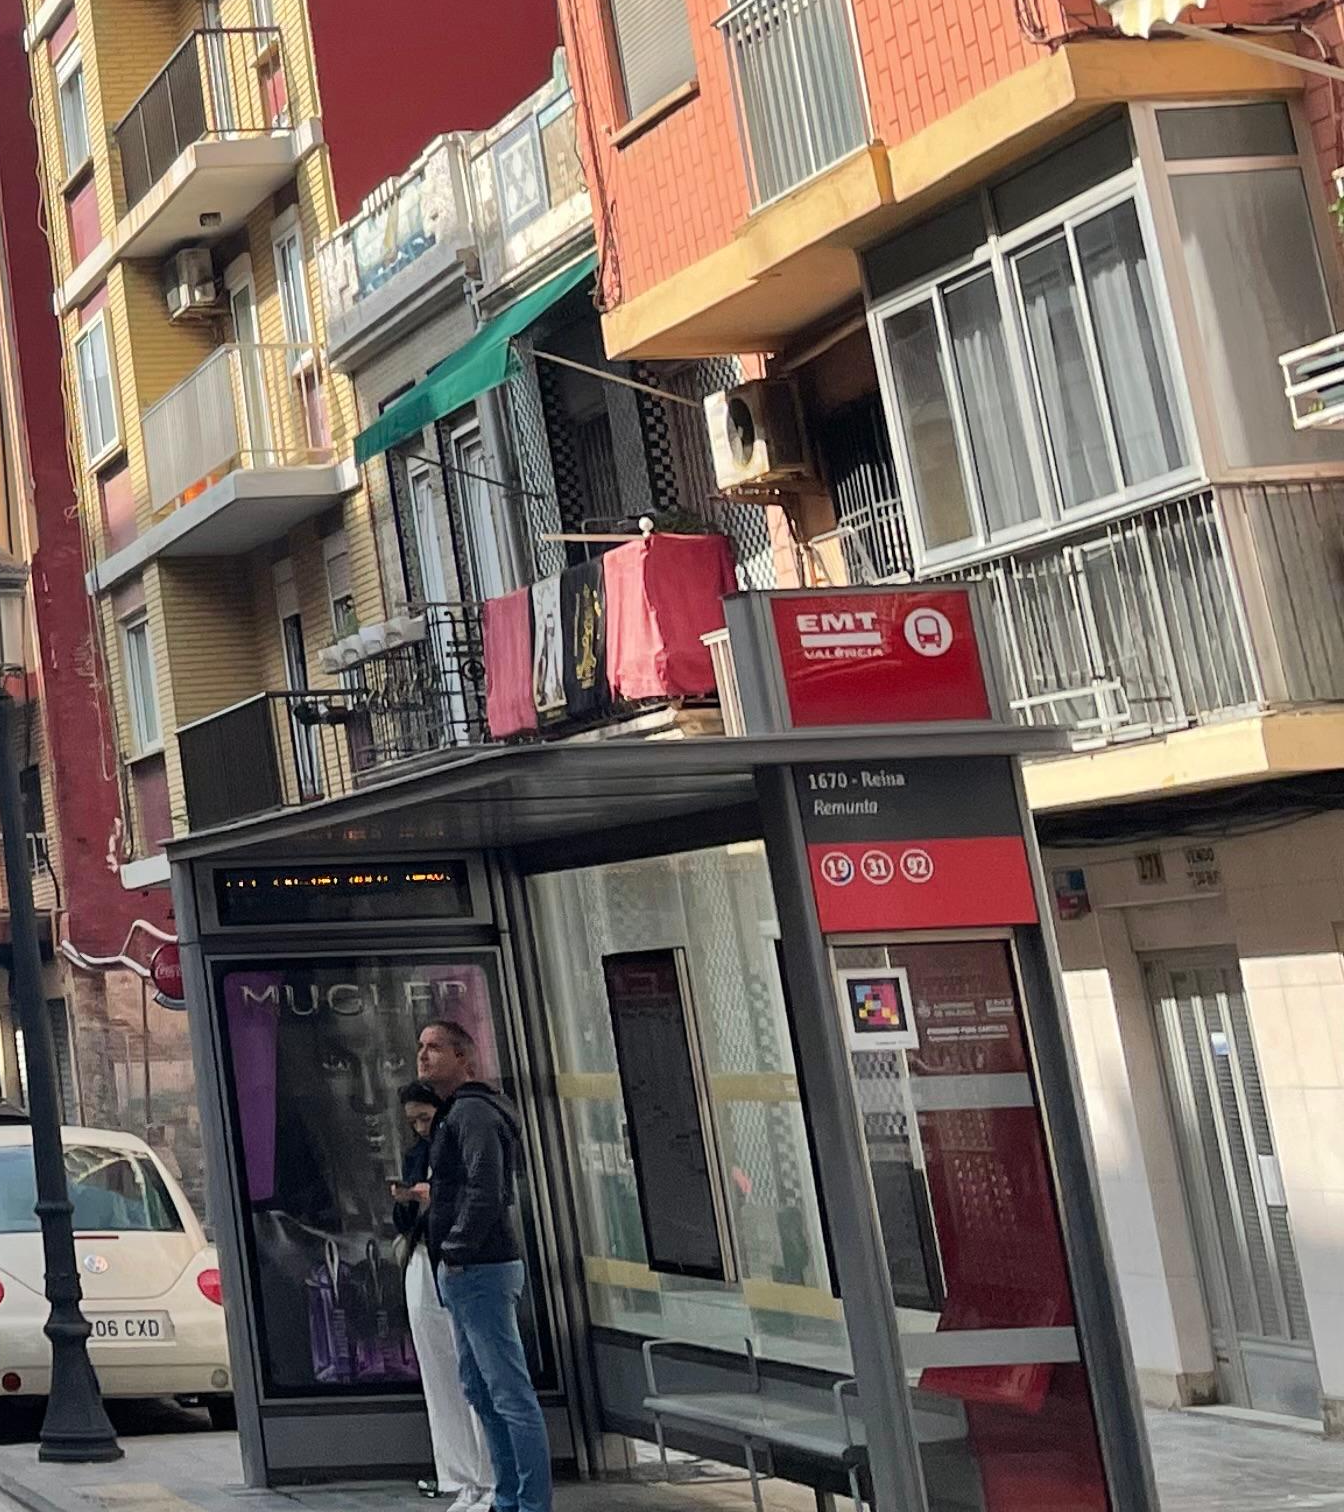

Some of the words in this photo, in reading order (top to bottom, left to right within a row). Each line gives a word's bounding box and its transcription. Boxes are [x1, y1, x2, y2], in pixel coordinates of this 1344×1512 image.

[796, 611, 878, 633] EMT
[808, 771, 848, 790] 1670
[860, 769, 906, 788] Reina
[814, 797, 878, 816] Remunta
[827, 858, 849, 878] 19
[867, 857, 888, 877] 31
[906, 856, 928, 875] 92
[91, 1319, 119, 1337] 06
[124, 1319, 160, 1337] CXD
